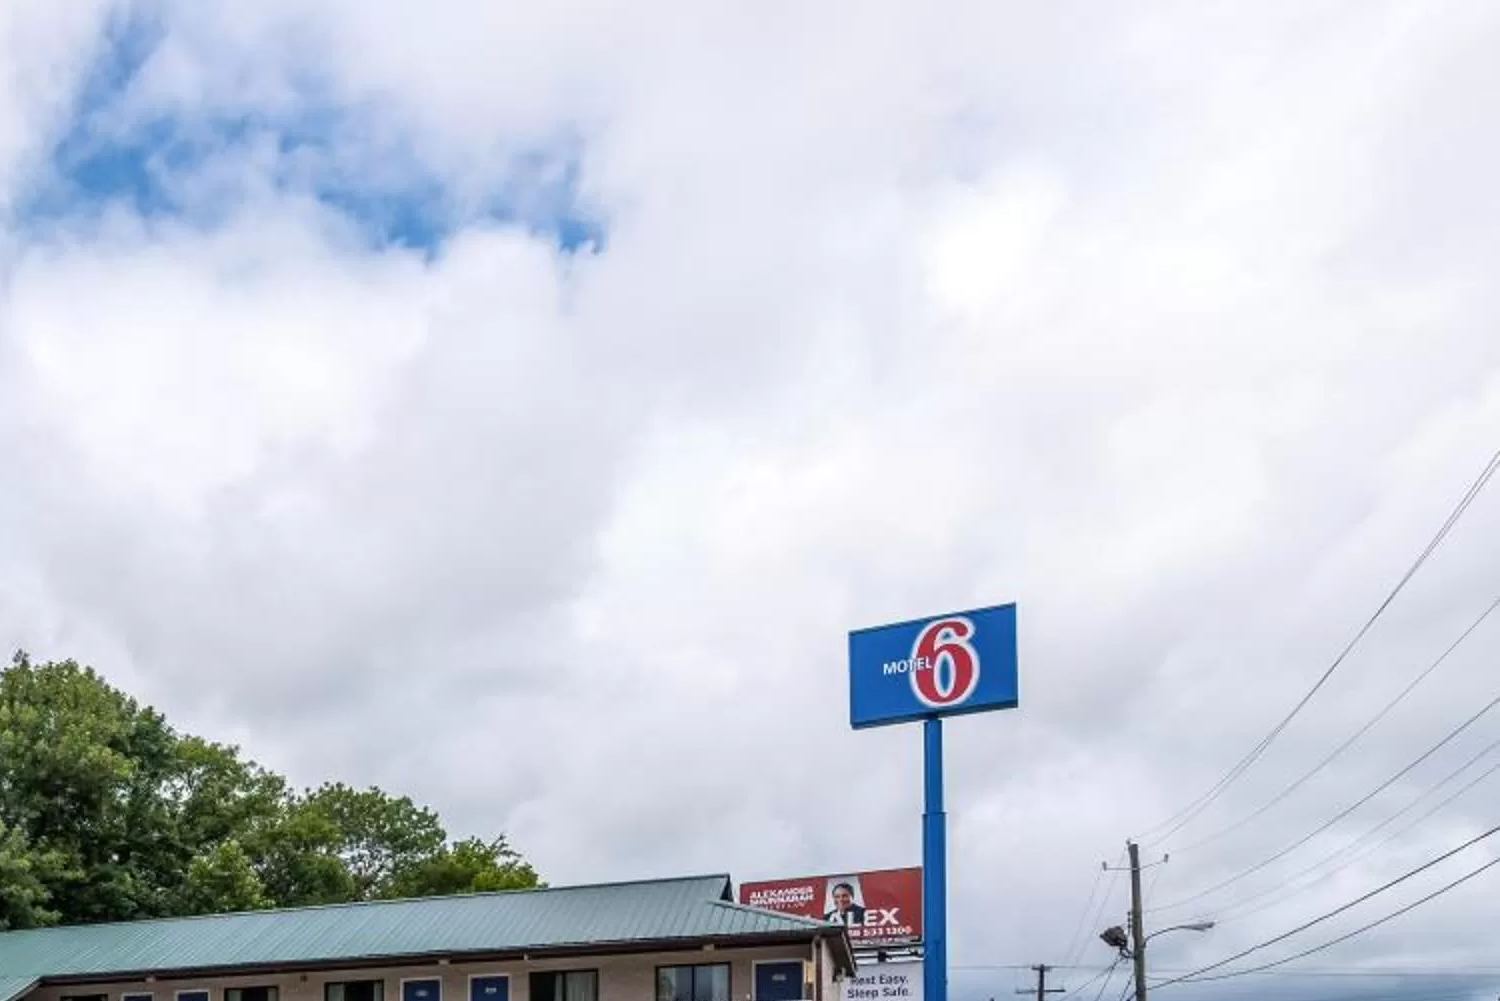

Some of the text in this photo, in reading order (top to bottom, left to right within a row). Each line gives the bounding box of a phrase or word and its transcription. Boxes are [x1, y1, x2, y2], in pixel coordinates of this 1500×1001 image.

[883, 617, 979, 706] MOTEL 6
[828, 907, 900, 928] ALEX
